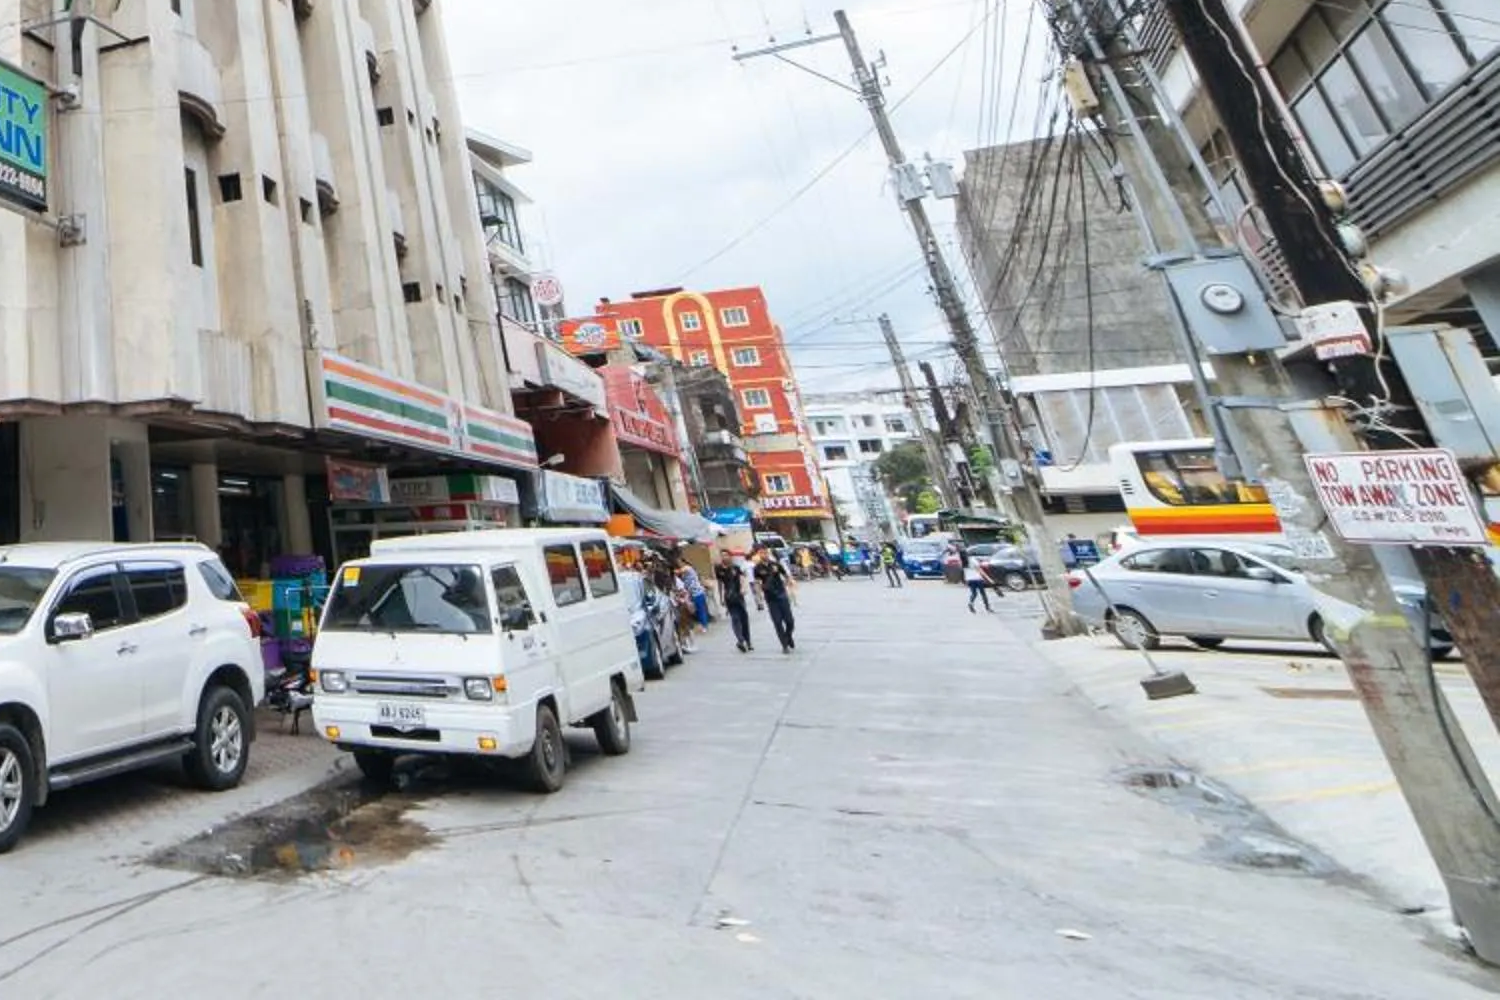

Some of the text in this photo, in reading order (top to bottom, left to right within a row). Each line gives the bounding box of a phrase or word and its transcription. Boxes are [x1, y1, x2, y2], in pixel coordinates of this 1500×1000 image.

[1313, 457, 1453, 483] NO PARKING
[1321, 484, 1358, 507] TOW
[1411, 483, 1466, 507] ZONE
